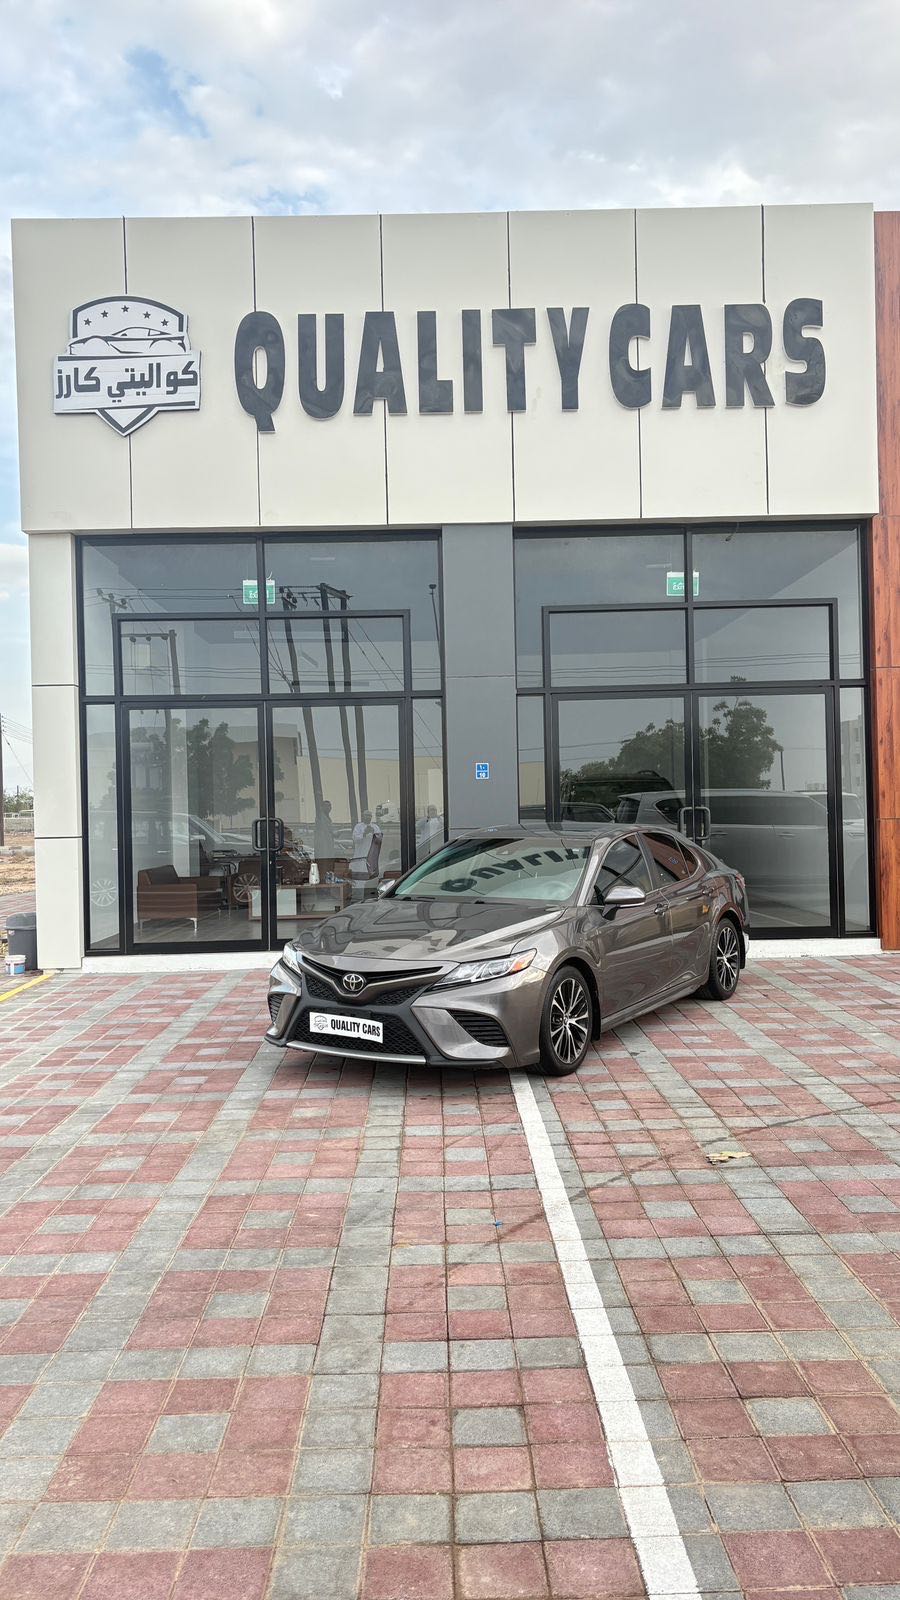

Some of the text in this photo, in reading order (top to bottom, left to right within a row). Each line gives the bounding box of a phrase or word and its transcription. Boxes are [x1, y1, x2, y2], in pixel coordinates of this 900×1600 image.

[55, 360, 198, 403] كواليتي كارز
[234, 297, 827, 433] QUALITY CARS
[330, 1018, 361, 1033] QUALITY
[362, 1023, 381, 1037] CARS
